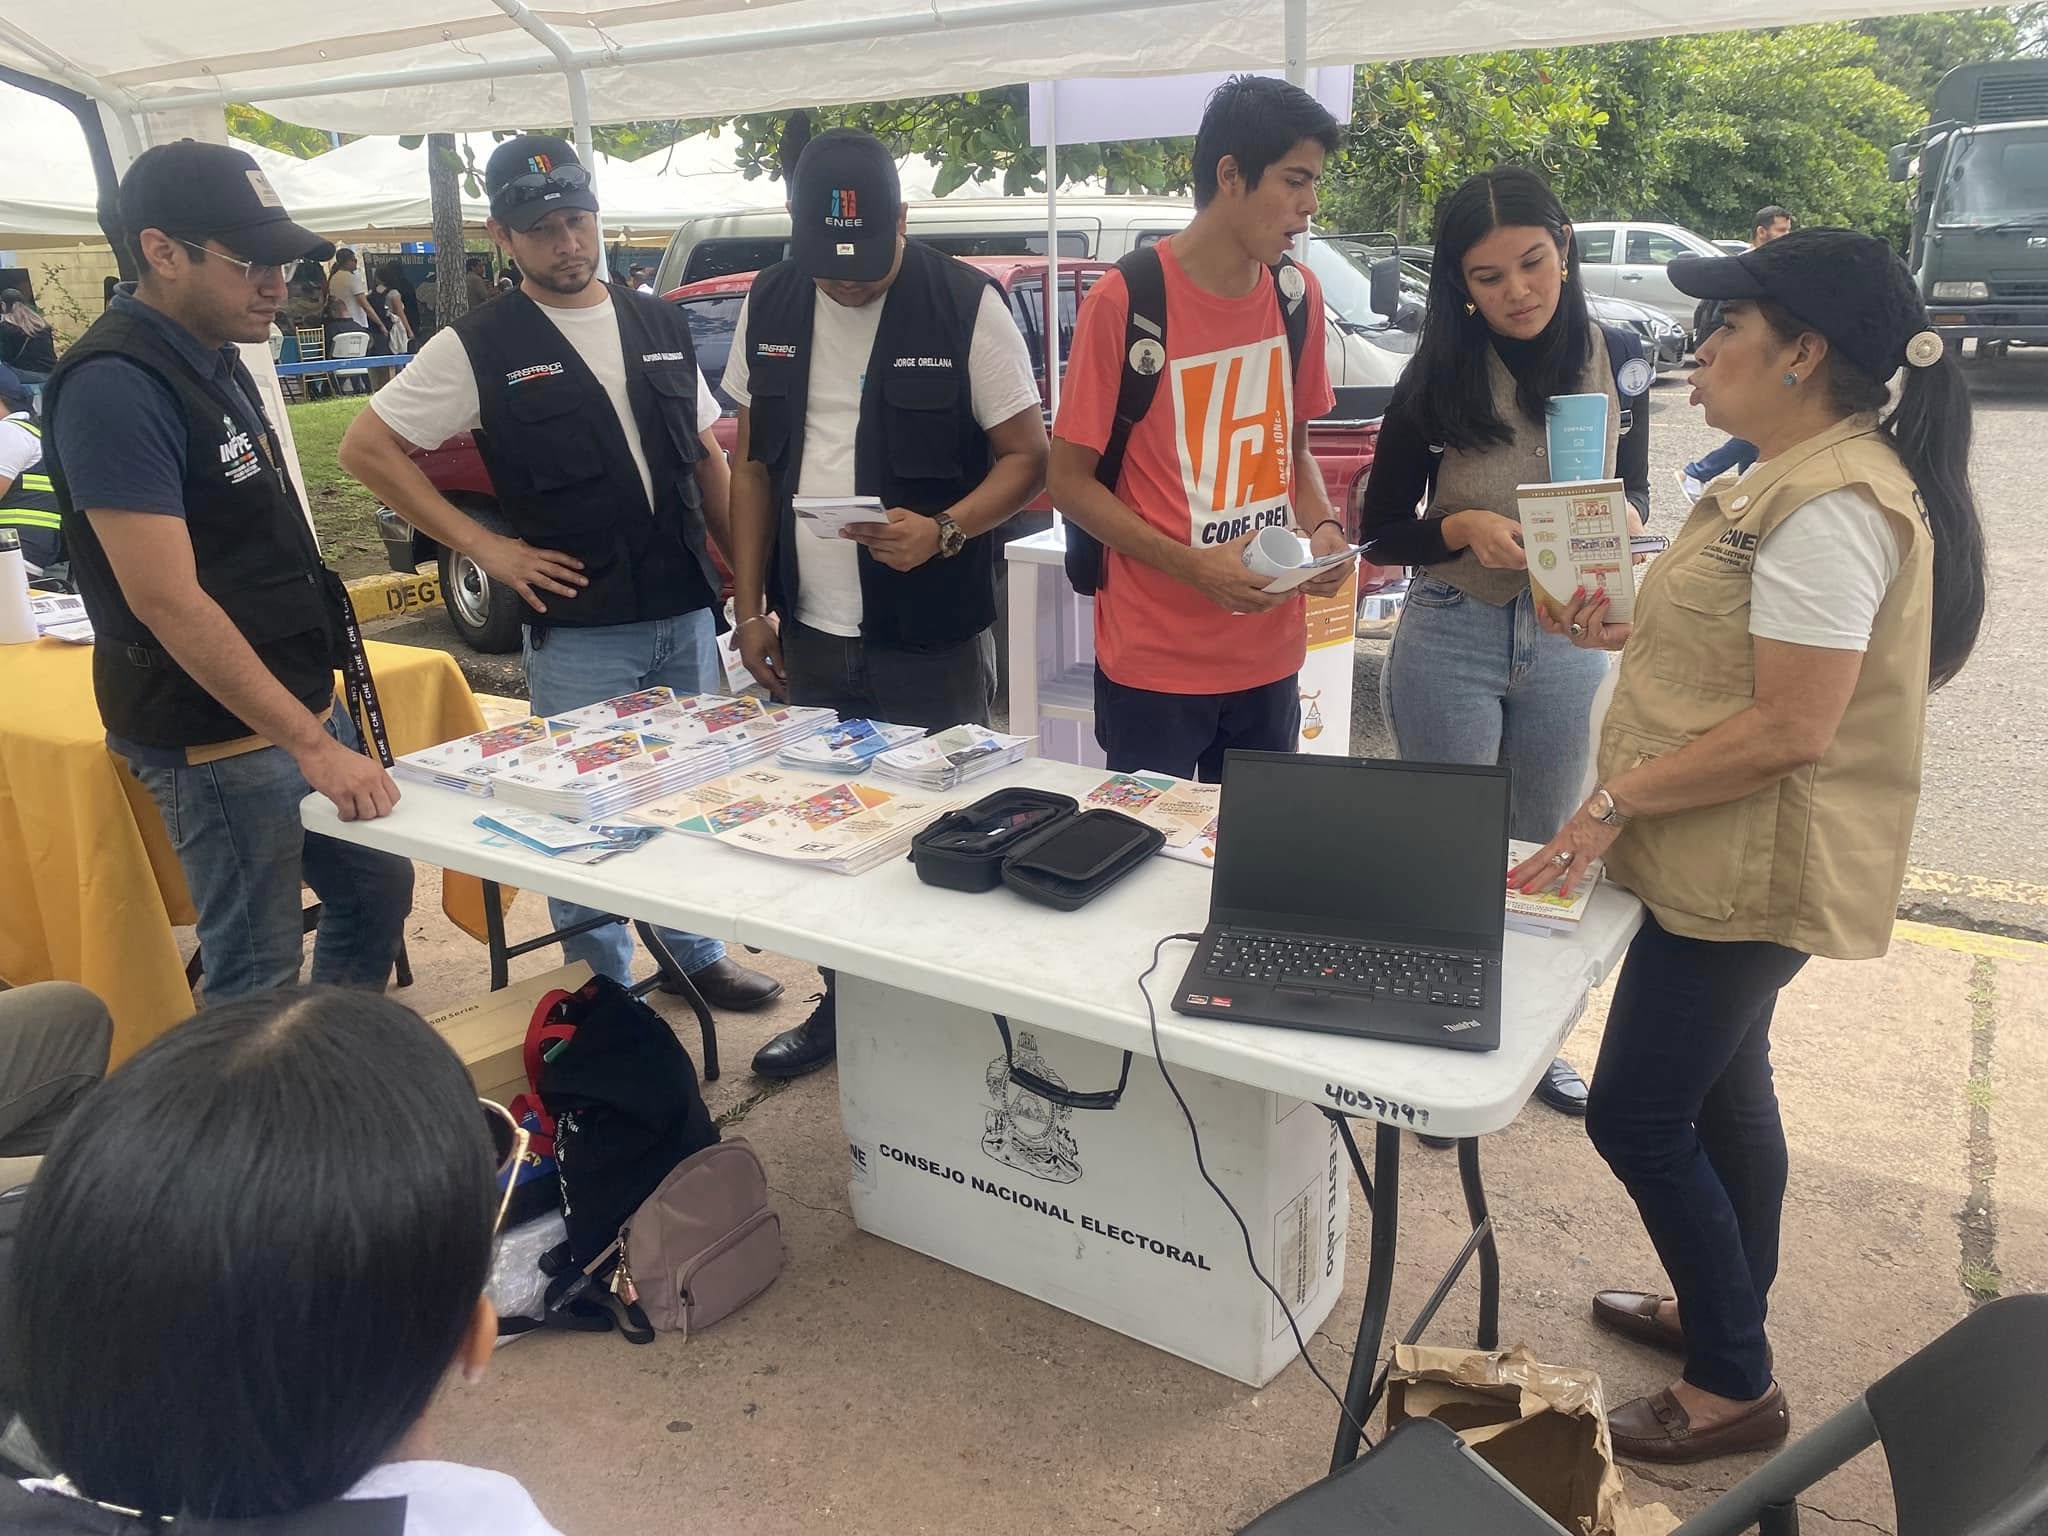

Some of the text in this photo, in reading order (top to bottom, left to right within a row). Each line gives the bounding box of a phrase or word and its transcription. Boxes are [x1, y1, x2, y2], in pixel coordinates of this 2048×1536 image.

[825, 217, 863, 227] ENEE
[893, 357, 953, 368] JORGE ORELLANA
[1719, 527, 1758, 551] CNE
[354, 654, 364, 671] CNE
[362, 682, 372, 699] CNE
[370, 711, 379, 728] CNE
[378, 739, 387, 756] CNE
[448, 1004, 480, 1018] Series
[1442, 1019, 1482, 1033] ThinkPad
[849, 1142, 867, 1167] NE
[1327, 1150, 1338, 1213] ESTE
[880, 1143, 1212, 1271] CONSEJO NACIONAL ELECTORAL
